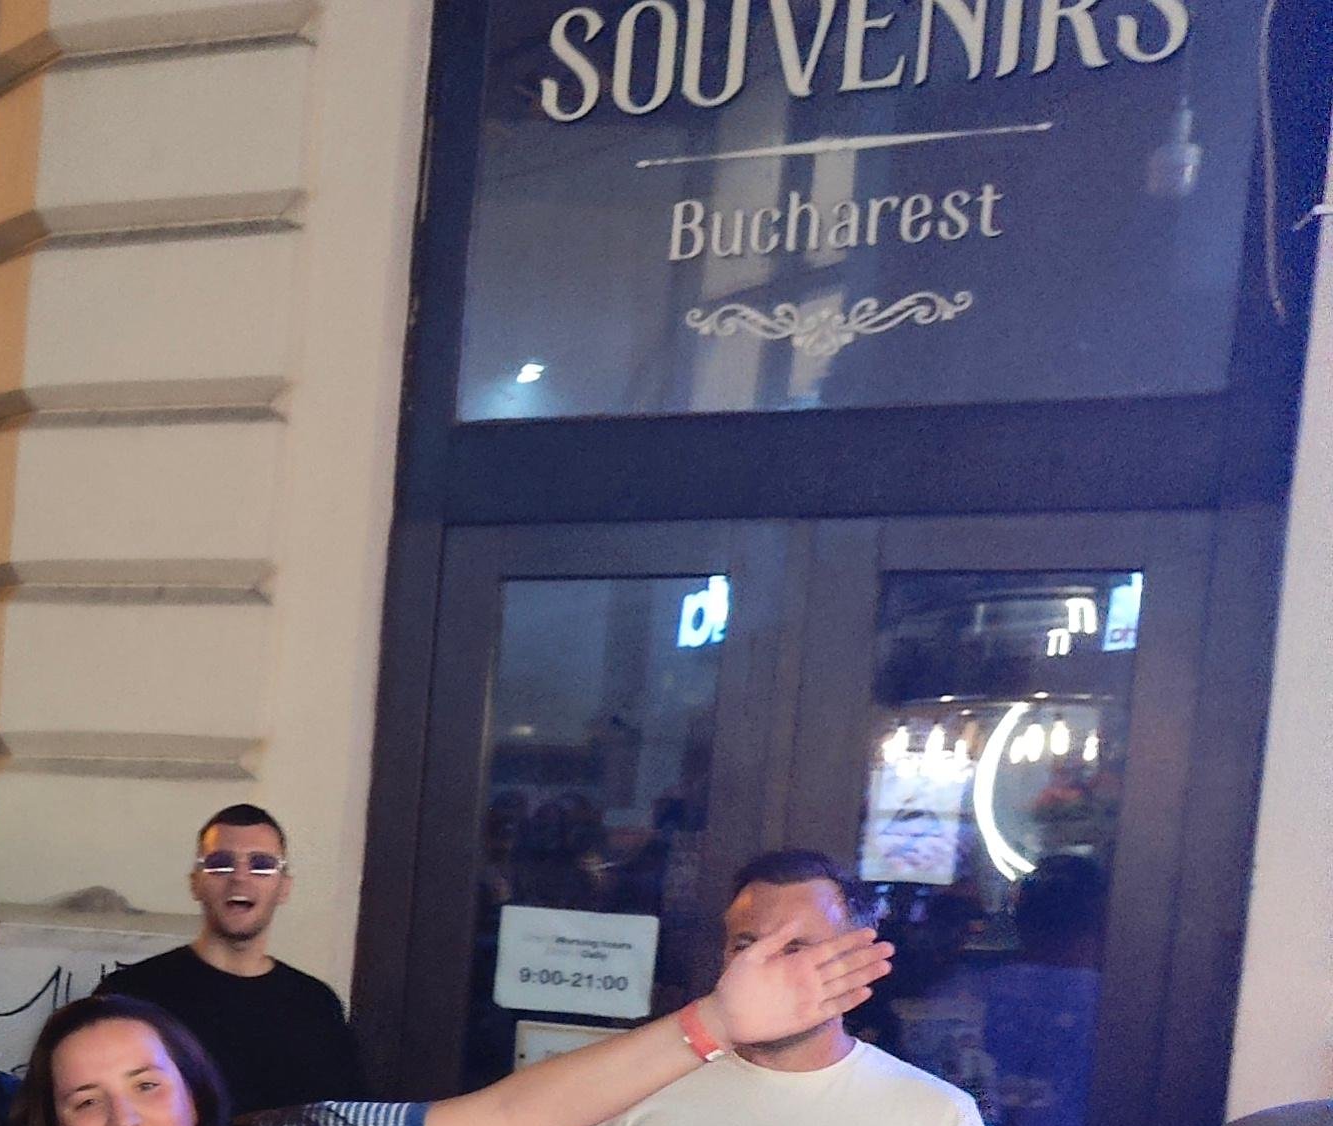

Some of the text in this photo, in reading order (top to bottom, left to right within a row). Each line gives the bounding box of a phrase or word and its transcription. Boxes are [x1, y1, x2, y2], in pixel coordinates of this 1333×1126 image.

[539, 0, 1192, 123] SOUVENIRS
[666, 181, 1004, 264] Bucharest
[519, 967, 629, 992] 9:00-21:00
